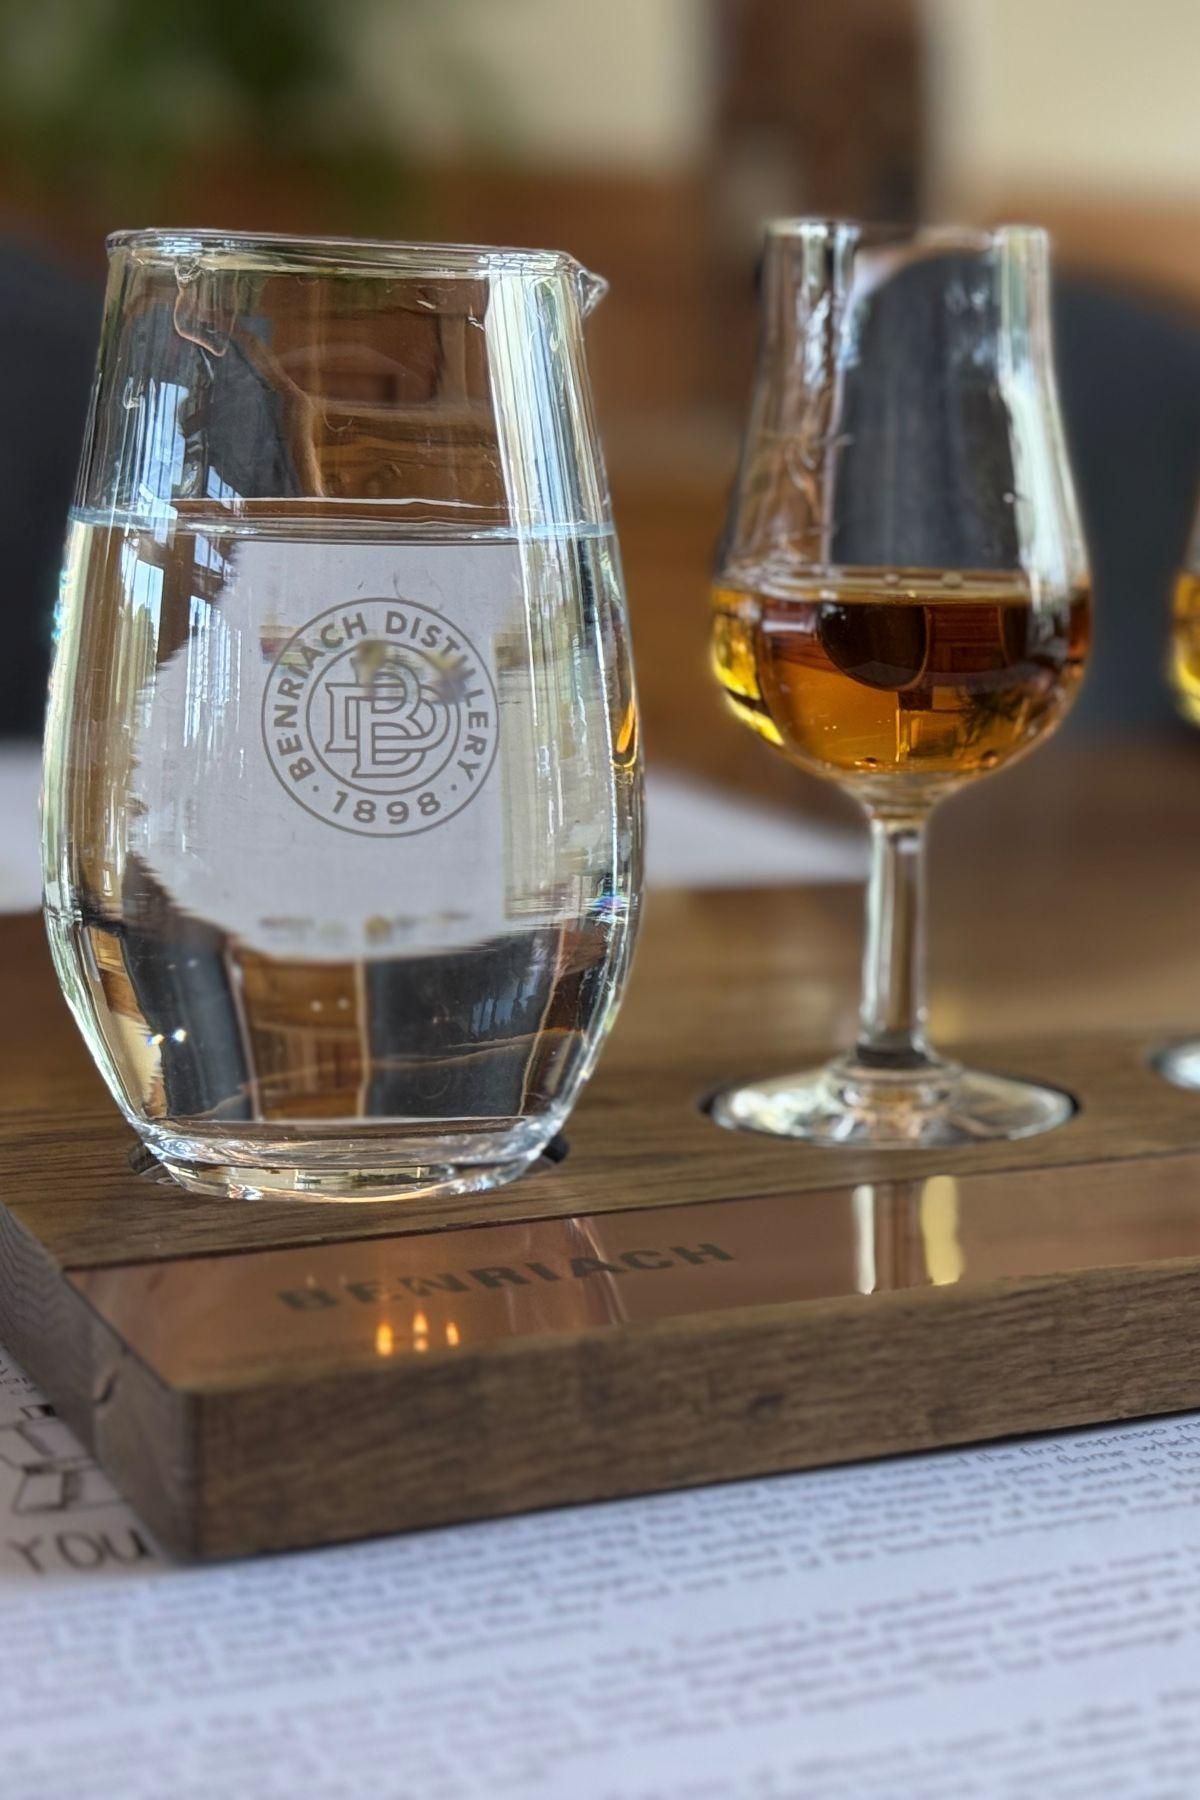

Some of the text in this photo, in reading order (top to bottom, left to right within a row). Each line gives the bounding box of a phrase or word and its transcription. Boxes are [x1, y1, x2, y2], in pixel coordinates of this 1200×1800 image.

[274, 612, 368, 783] BENRIACH
[333, 790, 441, 825] 1898
[277, 1241, 734, 1310] BENRIACH
[1074, 1428, 1167, 1447] espresso
[1138, 1457, 1166, 1466] to
